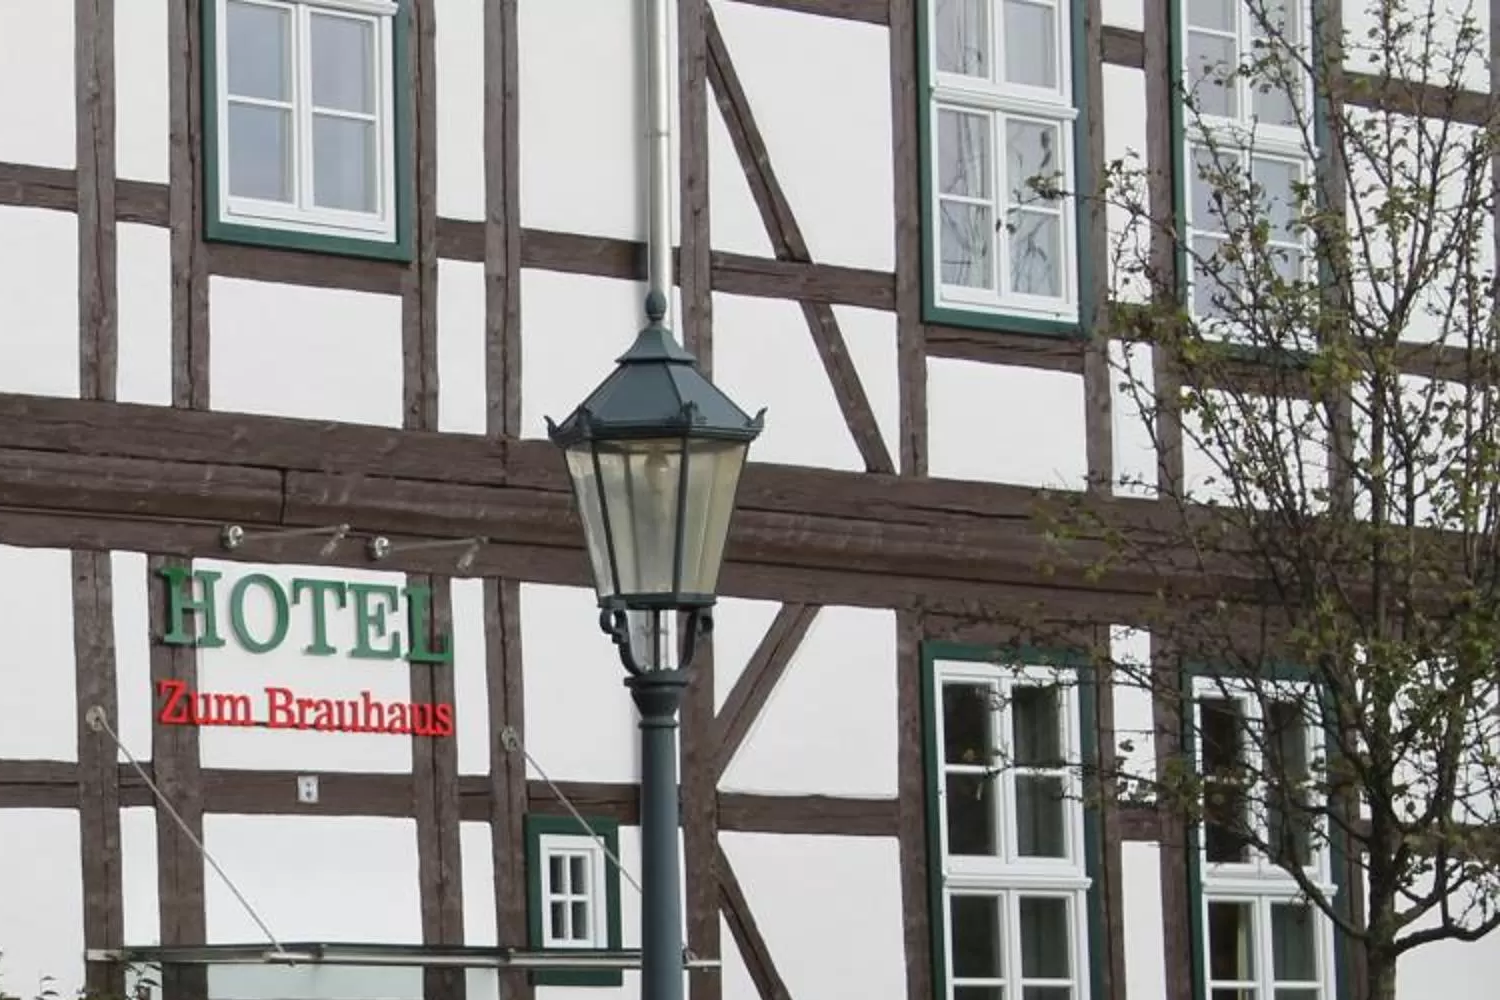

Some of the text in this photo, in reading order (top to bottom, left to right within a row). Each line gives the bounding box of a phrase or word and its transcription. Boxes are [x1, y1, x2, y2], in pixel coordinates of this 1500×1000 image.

[158, 566, 453, 663] HOTEL
[157, 679, 454, 736] Zum Brauhaus
